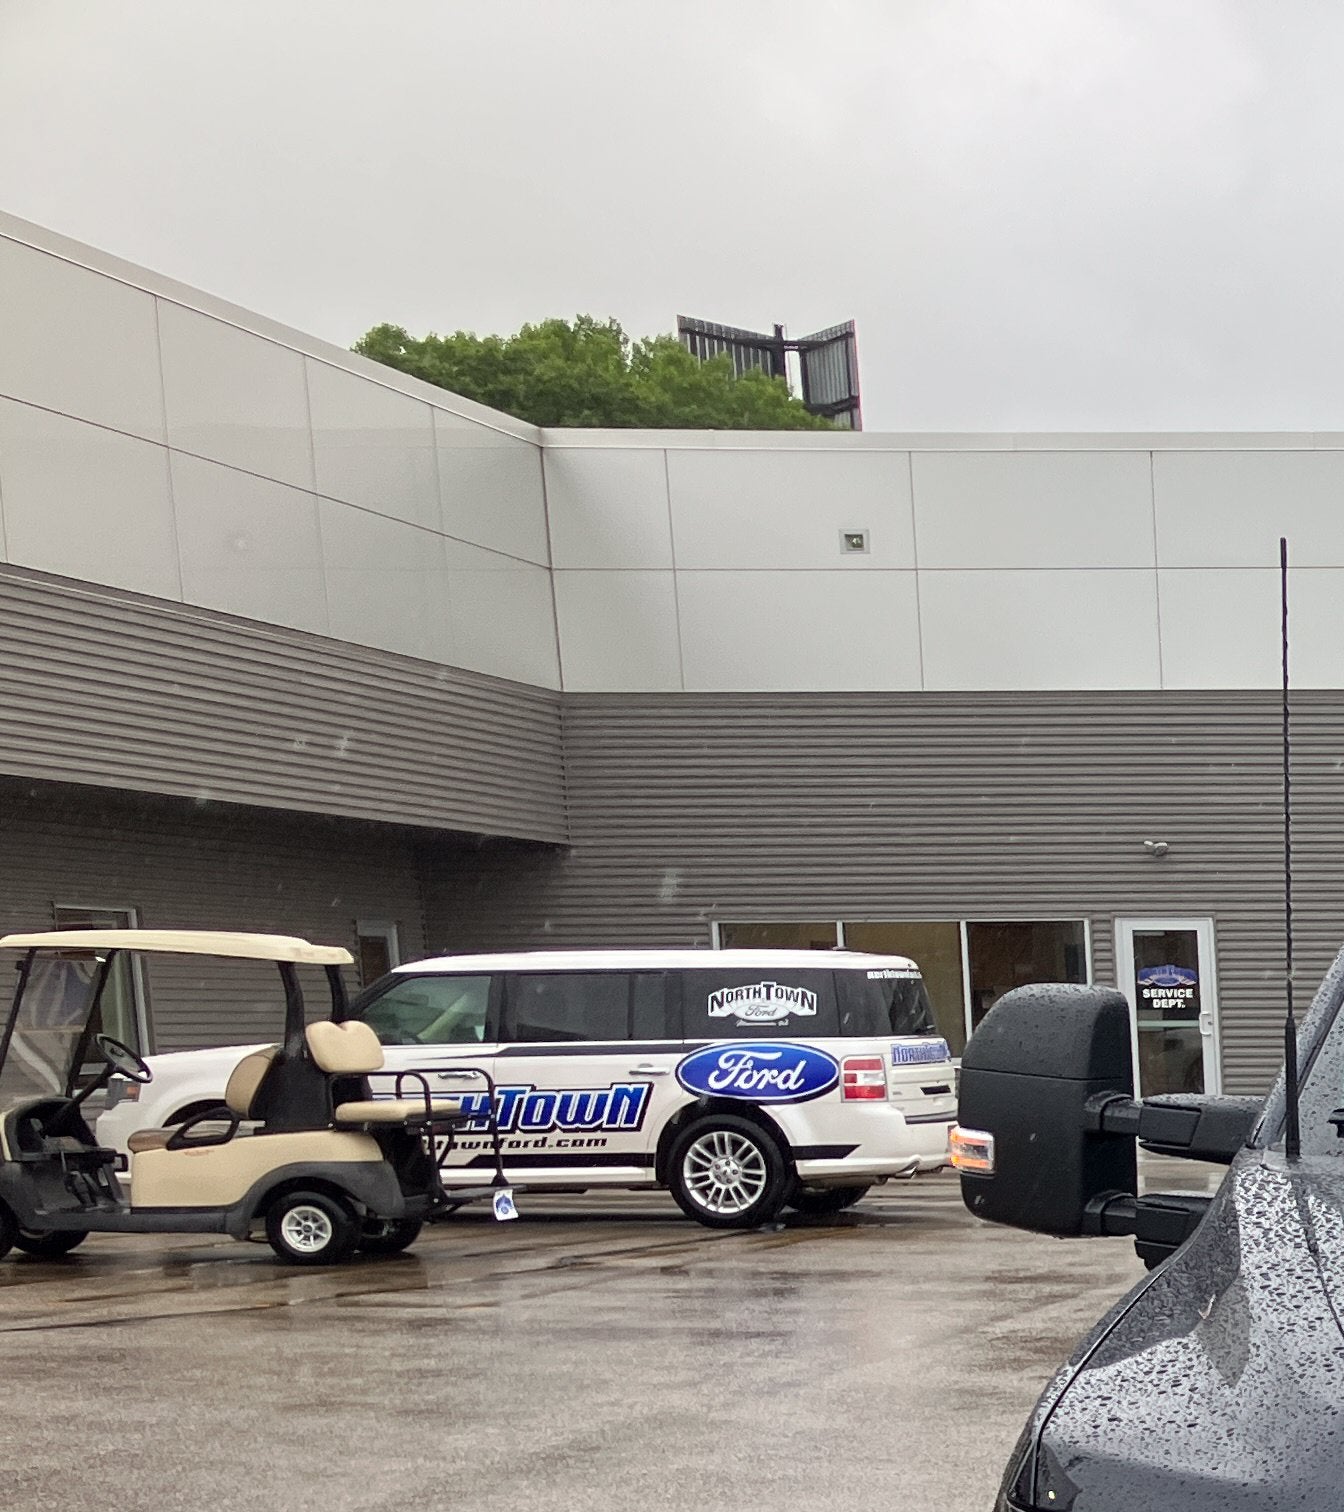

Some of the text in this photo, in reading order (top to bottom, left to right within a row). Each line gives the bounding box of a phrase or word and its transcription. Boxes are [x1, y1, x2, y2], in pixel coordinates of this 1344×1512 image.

[709, 982, 816, 1014] NORTHTOWN
[1142, 988, 1194, 999] SERVICE
[1152, 998, 1186, 1009] DEPT.
[744, 1004, 778, 1018] Ford
[707, 1050, 807, 1090] Ford
